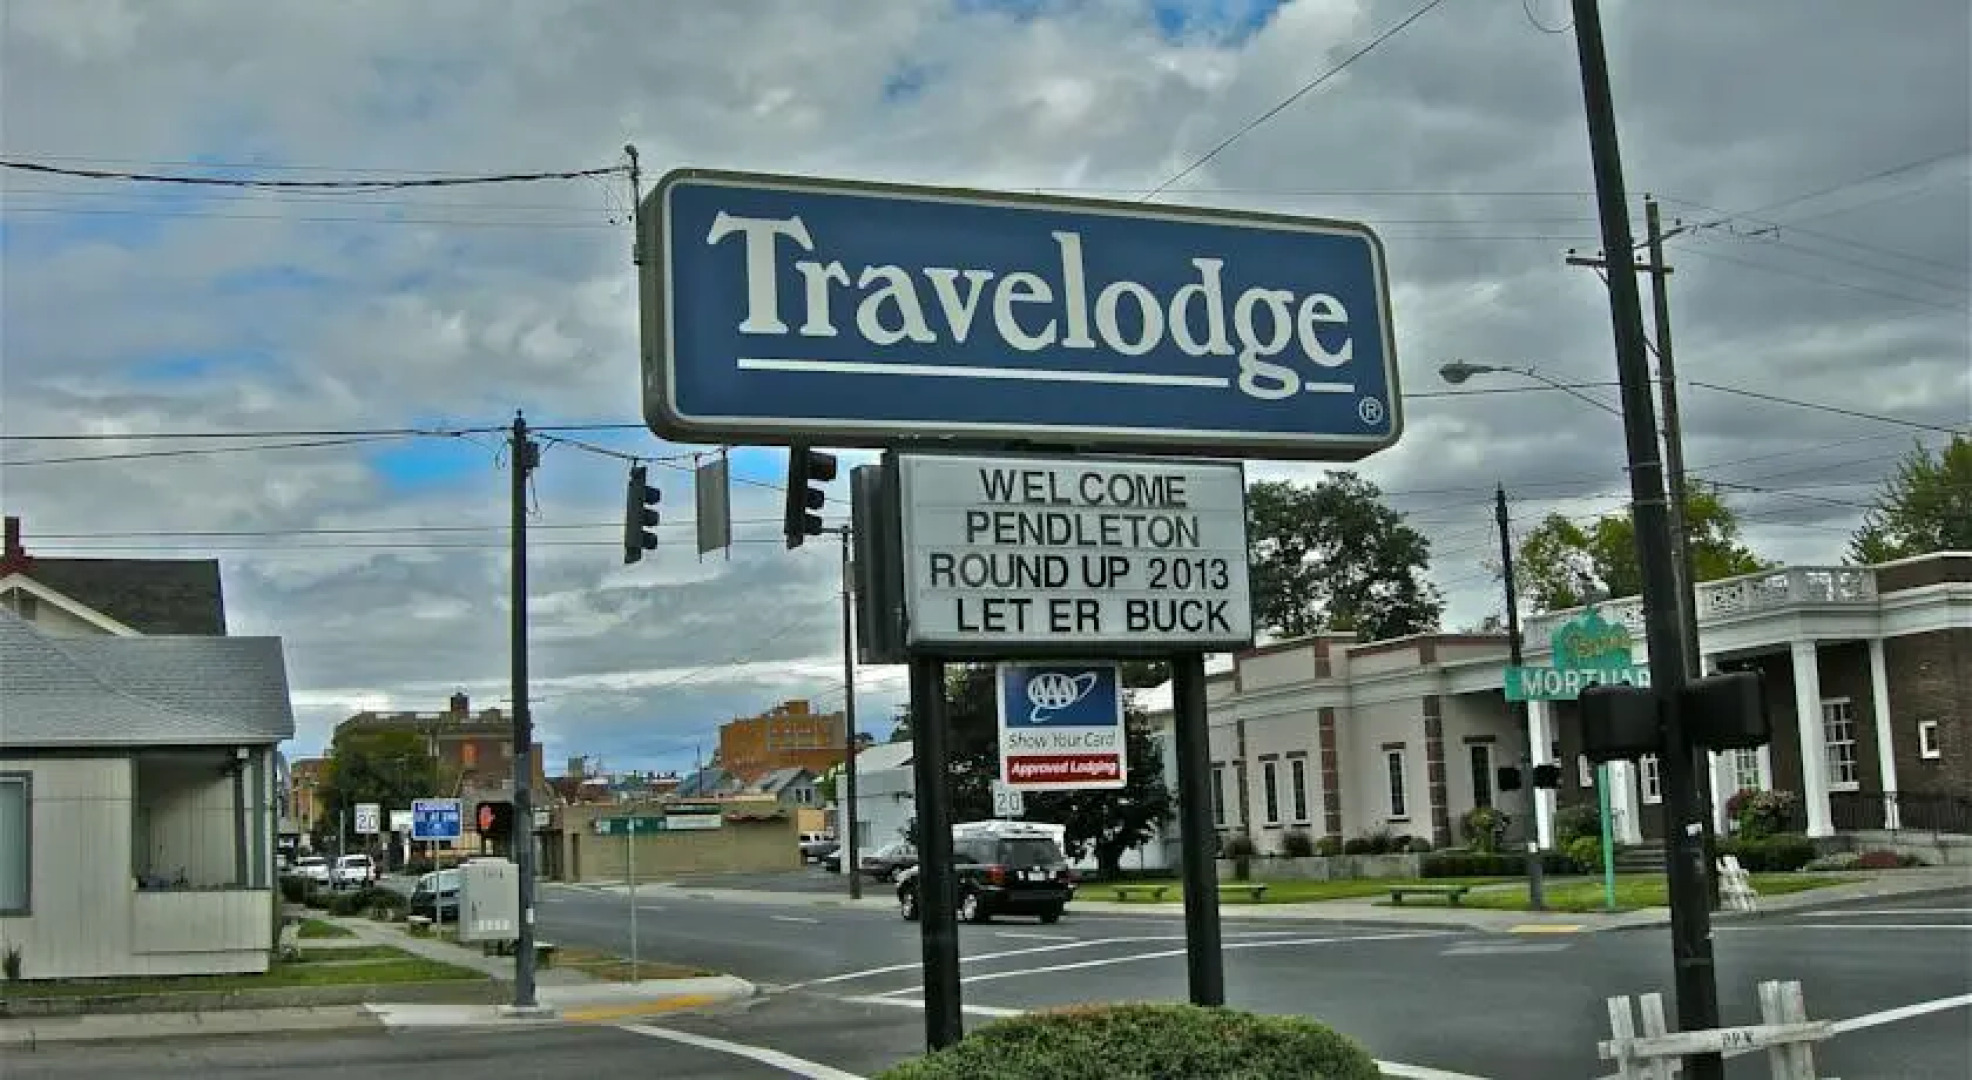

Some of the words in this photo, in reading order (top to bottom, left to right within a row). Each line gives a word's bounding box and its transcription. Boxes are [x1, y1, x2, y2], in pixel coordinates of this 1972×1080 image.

[706, 210, 1353, 399] Travelodge
[979, 469, 1186, 507] WELCOME
[966, 510, 1199, 547] PENDLETON
[930, 553, 1068, 588] ROUND
[1082, 556, 1130, 588] UP
[1149, 558, 1229, 589] 2013
[957, 598, 1033, 632] LET
[1051, 599, 1100, 632] ER
[1127, 599, 1230, 632] BUCK
[1031, 674, 1077, 708] AAA
[1521, 668, 1650, 695] MORTUAR
[1008, 732, 1047, 748] Show
[1052, 732, 1082, 747] Your
[1085, 732, 1116, 747] Card
[1011, 760, 1069, 778] Approved
[1070, 760, 1117, 776] Lodging
[997, 793, 1020, 811] 20
